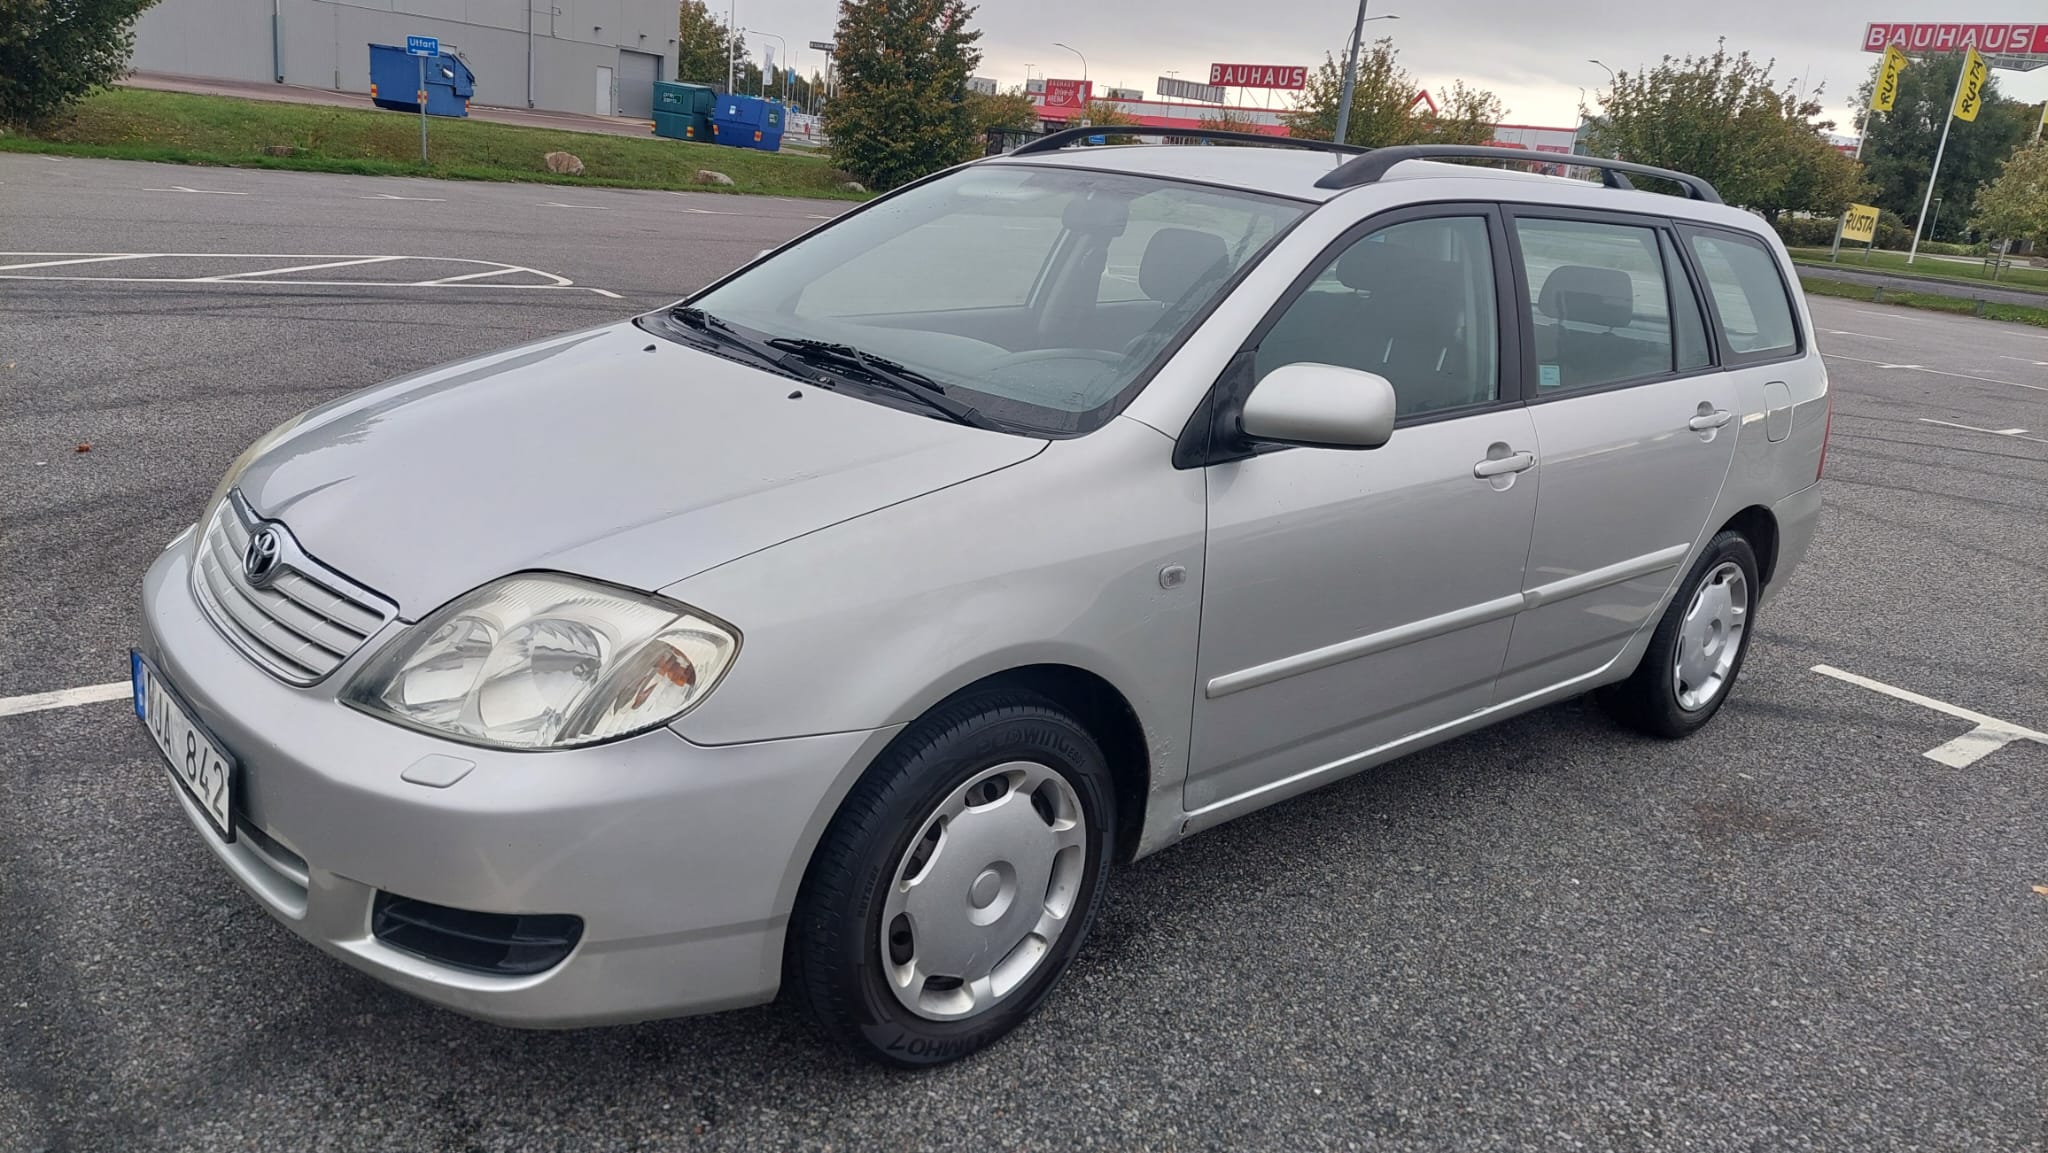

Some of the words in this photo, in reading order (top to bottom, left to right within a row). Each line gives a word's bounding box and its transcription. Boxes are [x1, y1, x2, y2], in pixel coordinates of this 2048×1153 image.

[409, 37, 436, 49] Utfart
[1867, 26, 2030, 49] BAUHAUS
[1211, 65, 1304, 87] BAUHAUS
[1881, 53, 1900, 105] RUSTA
[1961, 59, 1983, 114] RUSTA
[1844, 212, 1875, 233] RUSTA
[186, 729, 225, 820] 842
